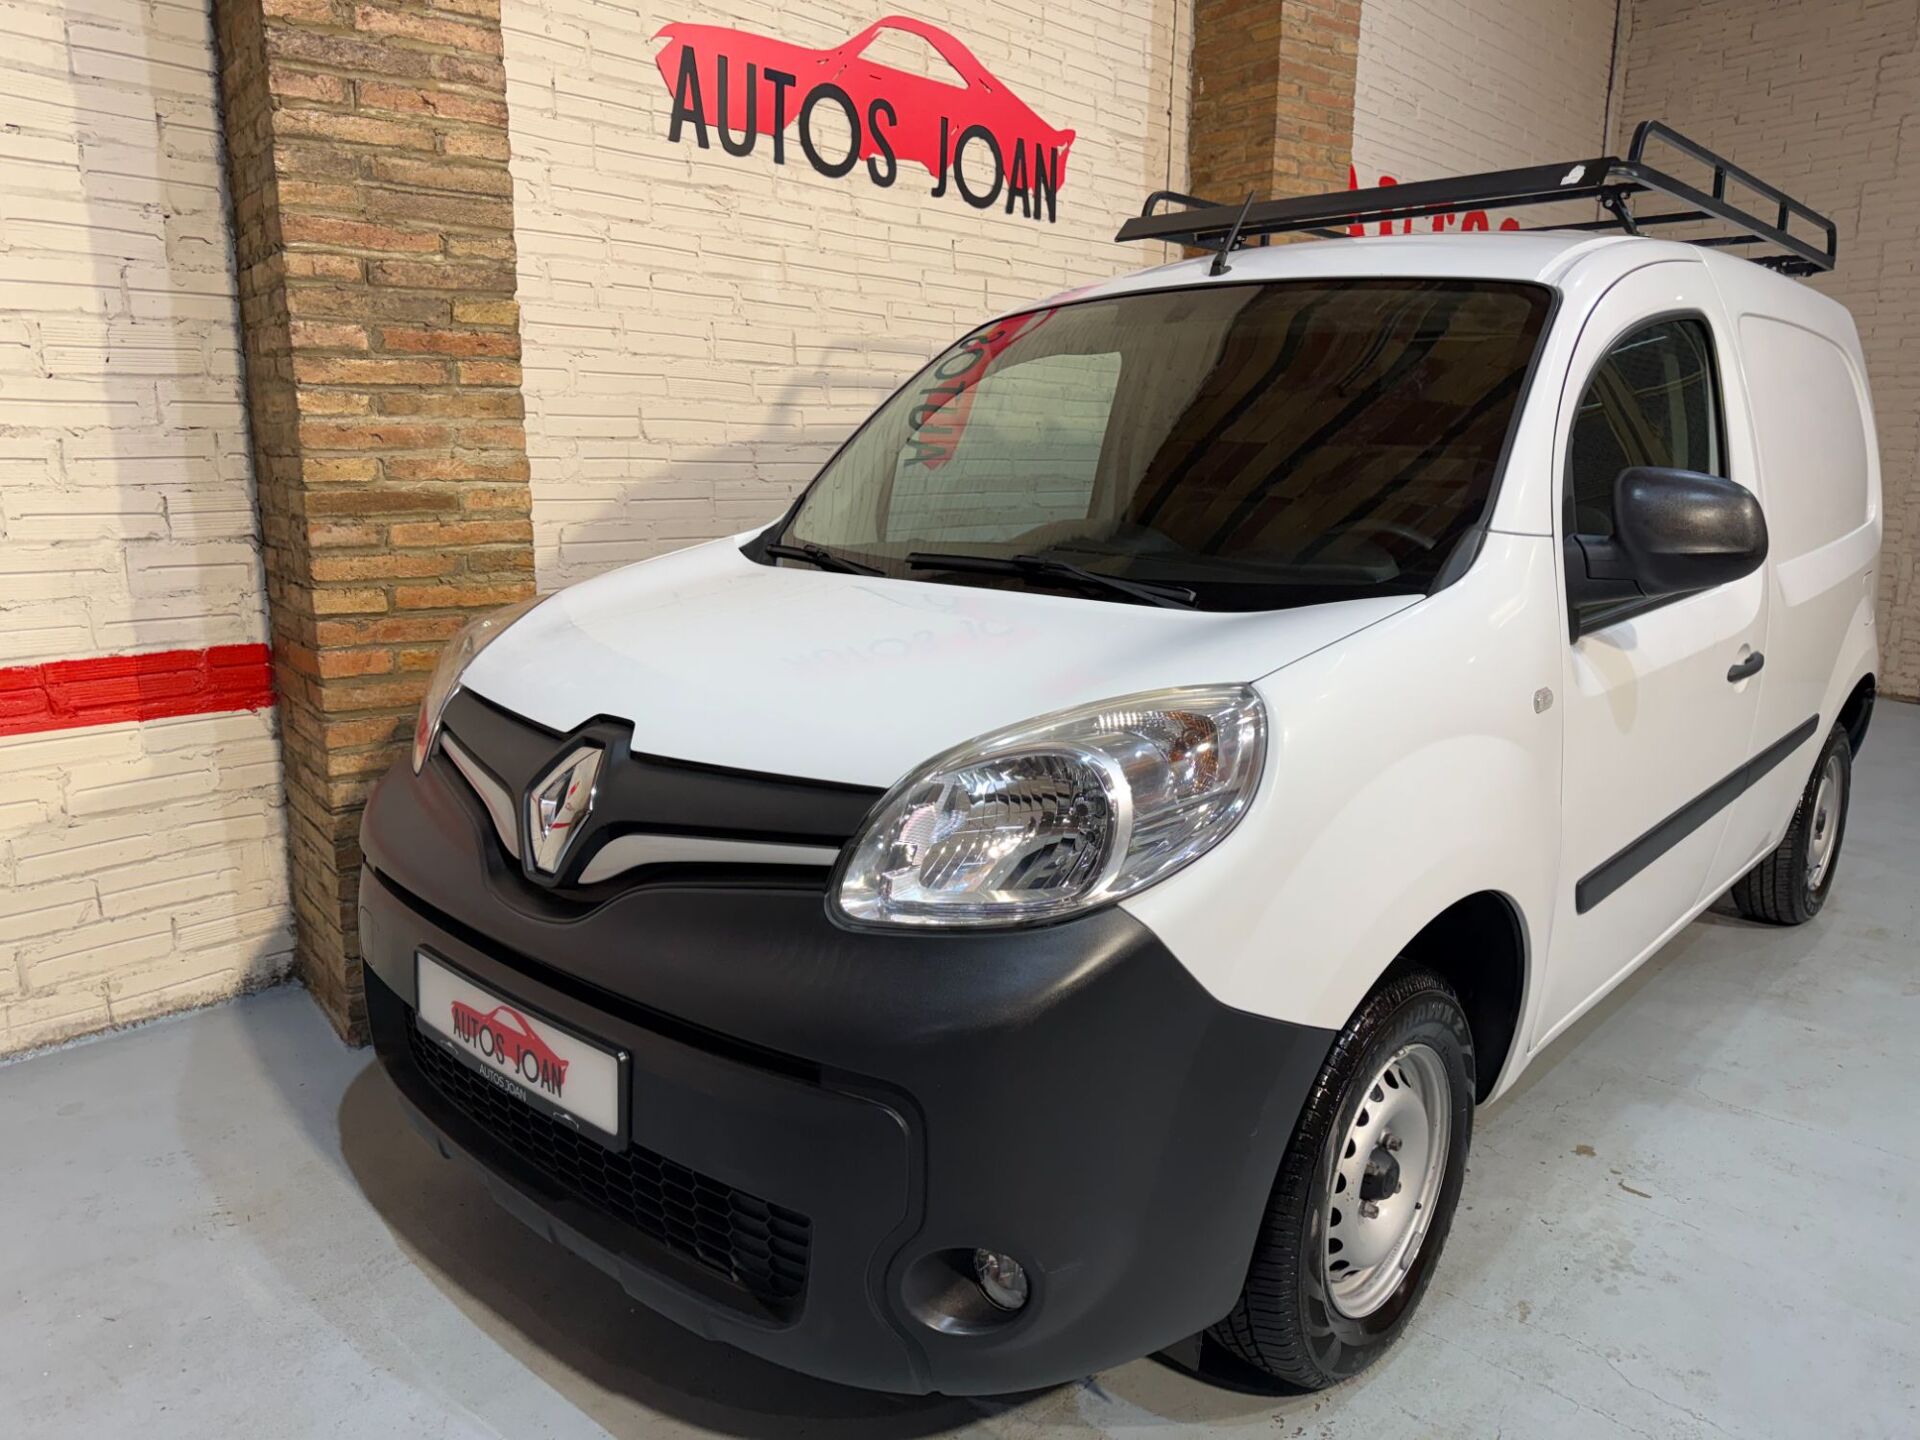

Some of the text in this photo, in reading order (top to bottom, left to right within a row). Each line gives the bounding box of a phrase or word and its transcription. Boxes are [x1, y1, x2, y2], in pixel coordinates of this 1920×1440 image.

[668, 45, 1058, 223] AUTOS JOAN
[453, 1008, 562, 1098] AUTOS JOAN
[479, 1063, 527, 1103] AUTOS JOAN
